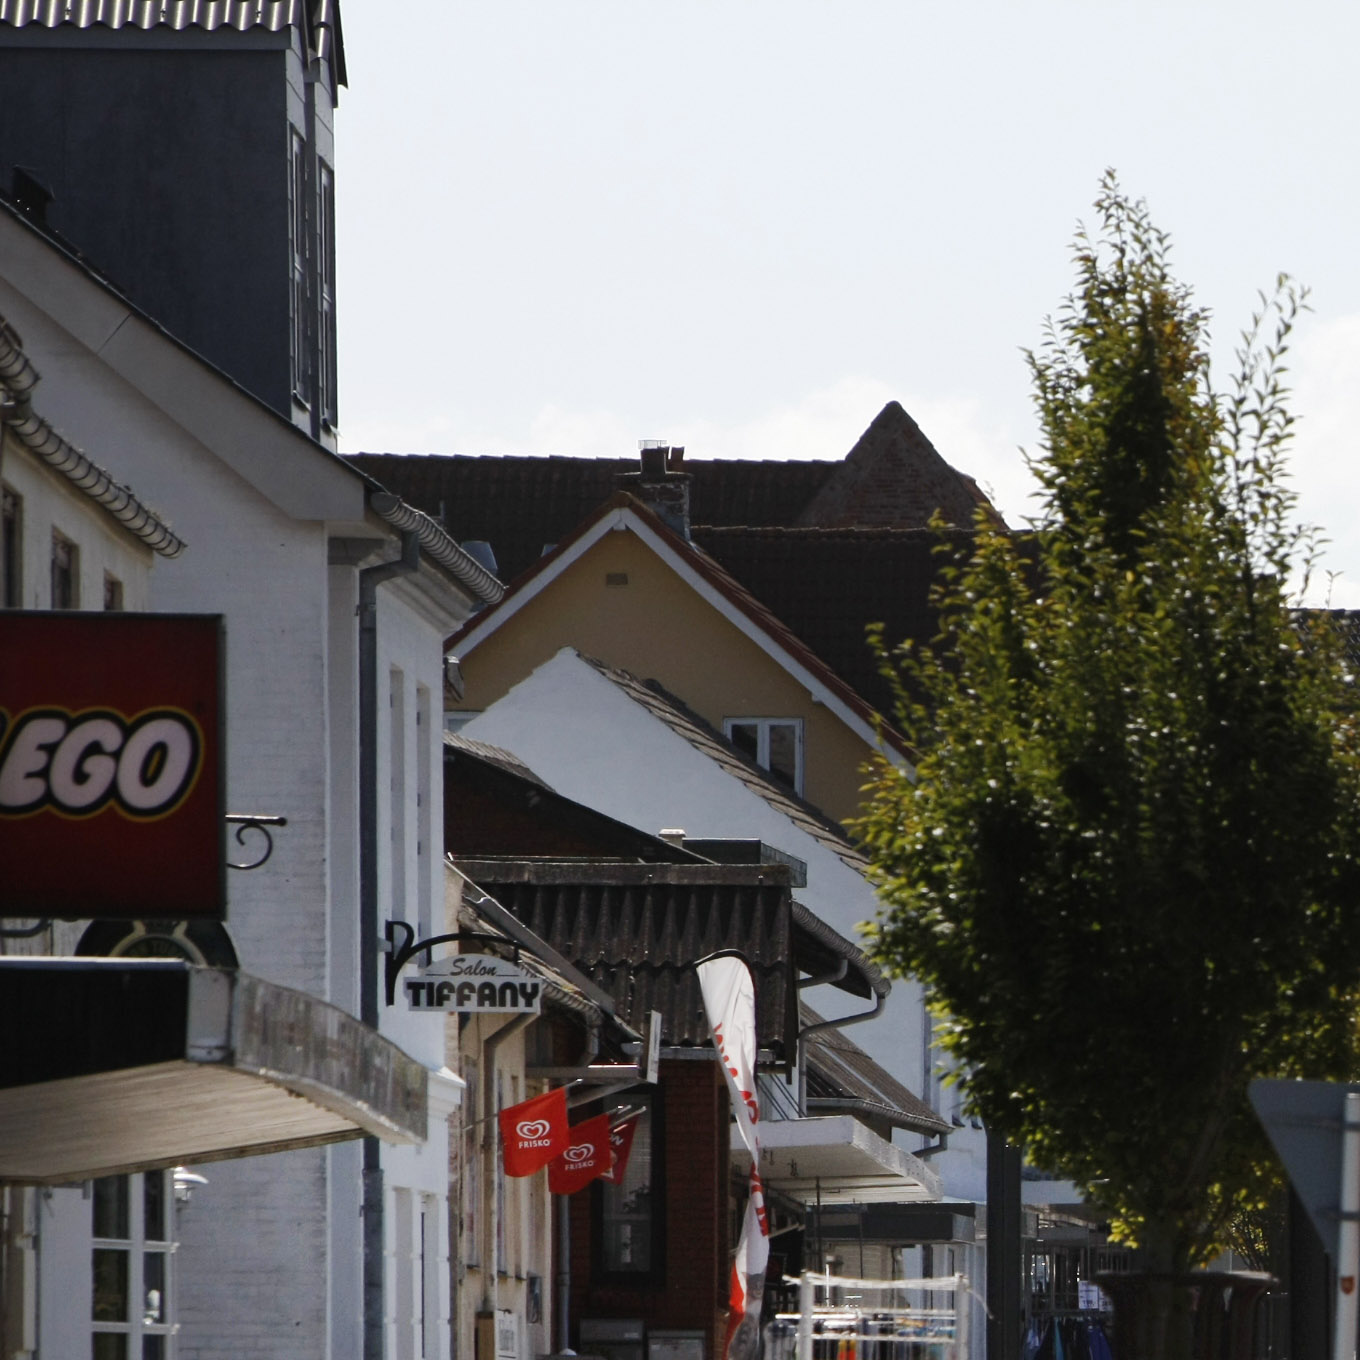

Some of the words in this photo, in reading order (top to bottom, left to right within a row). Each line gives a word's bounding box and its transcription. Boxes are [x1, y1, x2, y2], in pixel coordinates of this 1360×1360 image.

[0, 713, 197, 814] EGO
[450, 957, 497, 977] Salon
[406, 981, 540, 1008] TIFFANY
[518, 1139, 551, 1149] FRISKO
[564, 1160, 595, 1171] FRISKO
